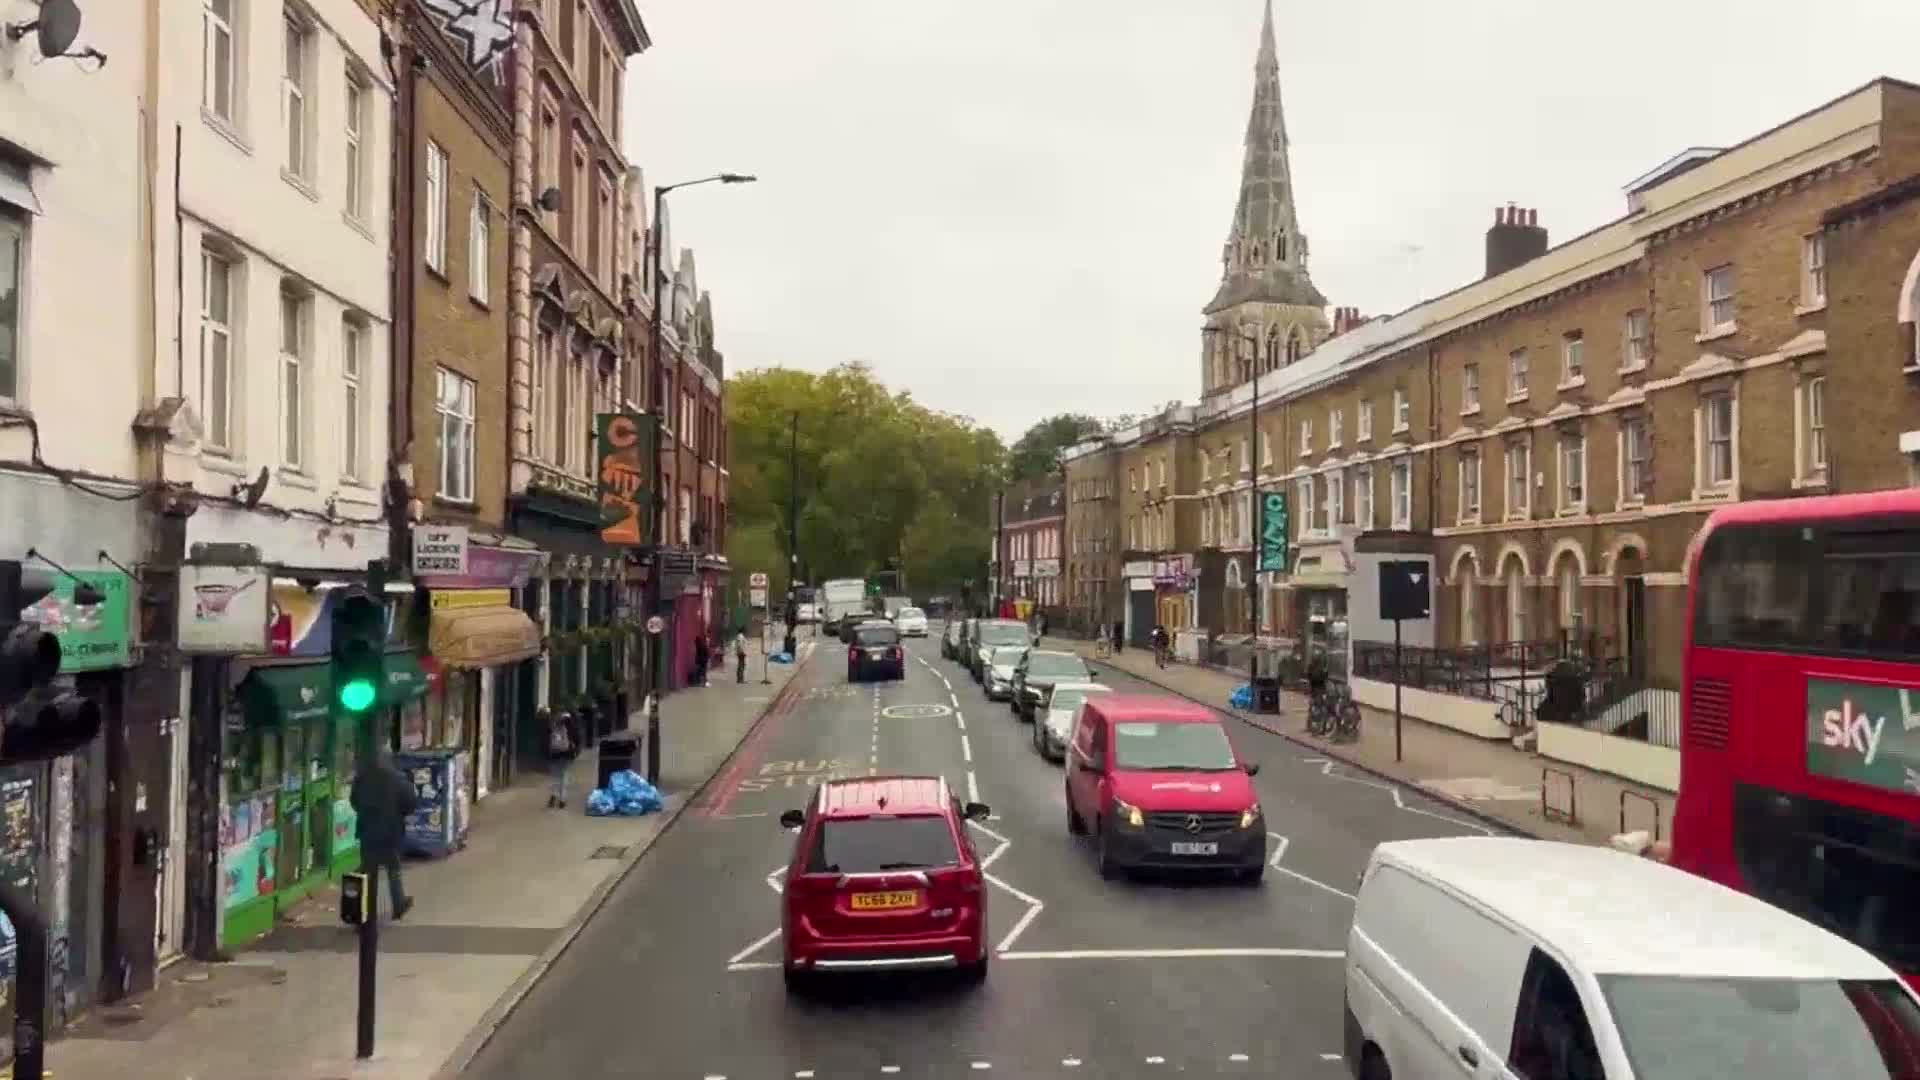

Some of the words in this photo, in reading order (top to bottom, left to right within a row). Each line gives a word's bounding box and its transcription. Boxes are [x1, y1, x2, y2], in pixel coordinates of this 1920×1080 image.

[416, 556, 460, 569] OPEN
[1823, 699, 1885, 765] sky
[760, 758, 848, 775] BUS
